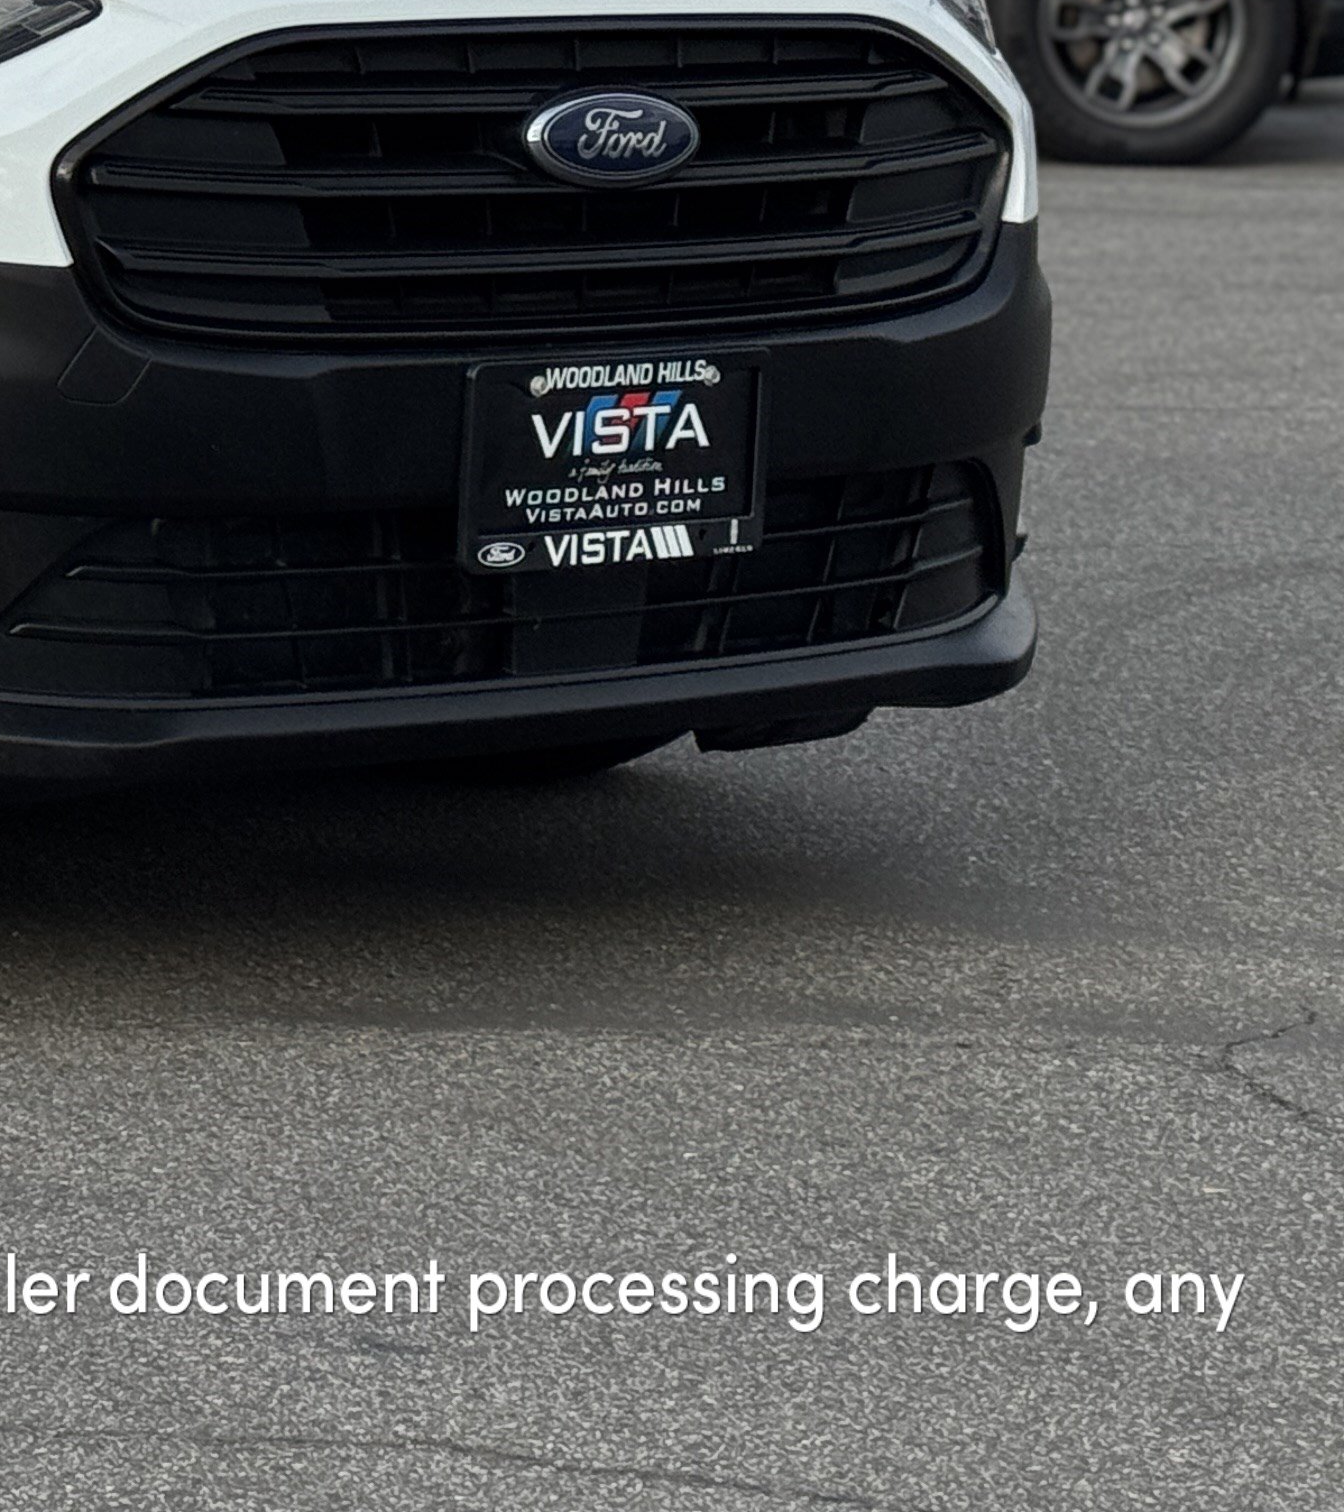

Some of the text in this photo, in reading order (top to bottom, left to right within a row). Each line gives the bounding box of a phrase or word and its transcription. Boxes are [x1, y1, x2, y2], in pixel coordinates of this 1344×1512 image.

[577, 107, 668, 160] Ford
[544, 359, 708, 390] WOODLAND HILLS
[530, 402, 712, 460] VISTA
[504, 476, 726, 508] WOODLAND HILLS
[543, 527, 654, 568] VISTA
